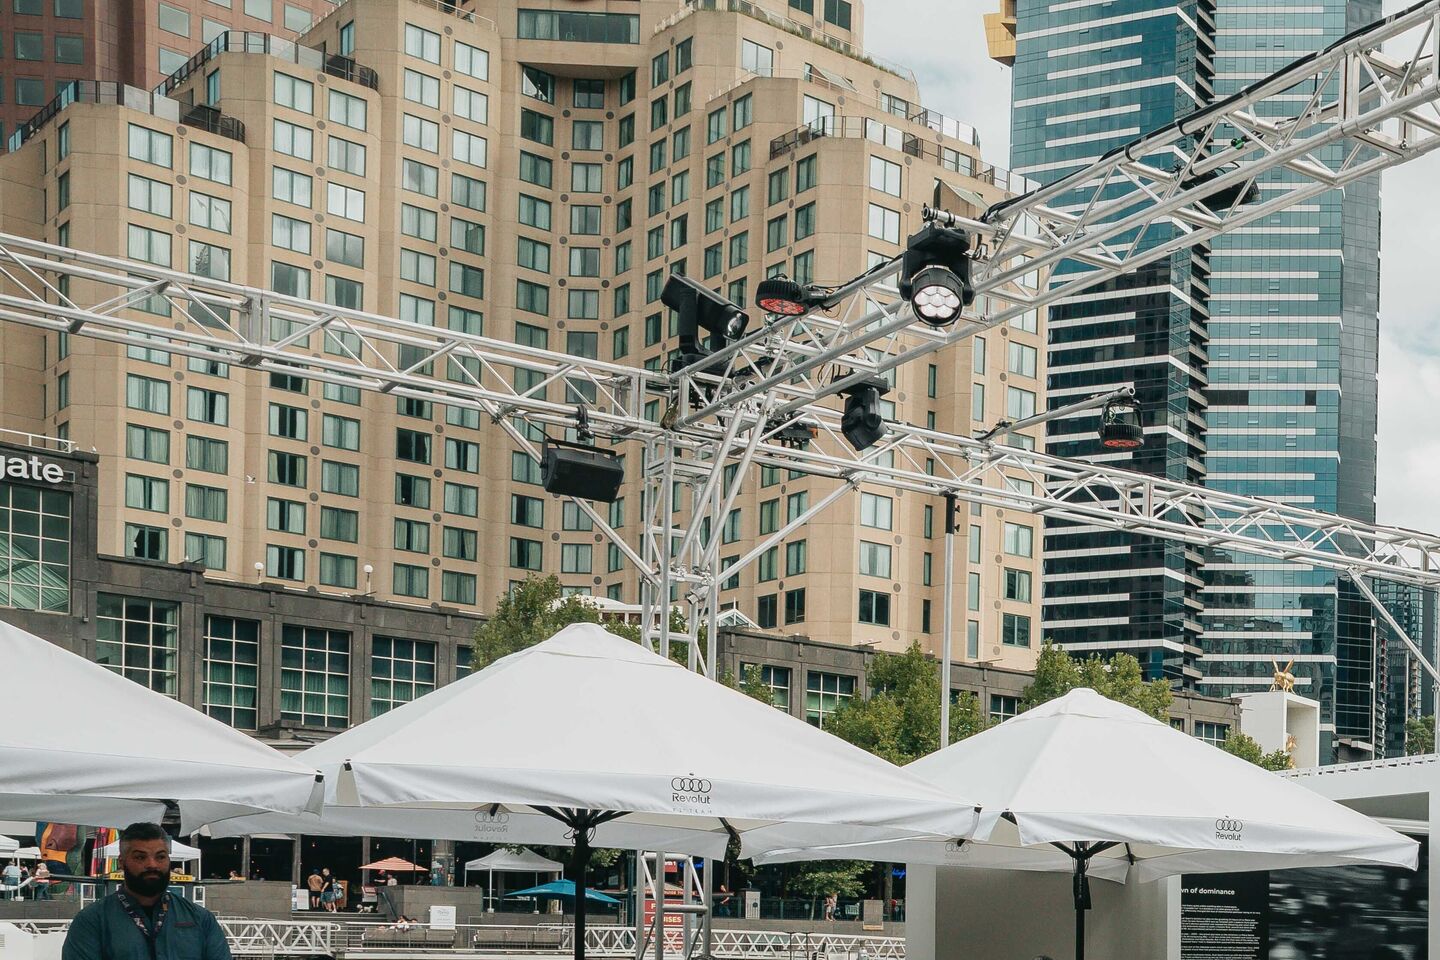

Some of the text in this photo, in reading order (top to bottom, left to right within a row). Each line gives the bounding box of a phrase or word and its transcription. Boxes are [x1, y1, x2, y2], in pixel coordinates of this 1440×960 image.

[672, 792, 711, 804] Revolut
[1216, 831, 1241, 841] Revolut
[1198, 887, 1235, 896] dominance
